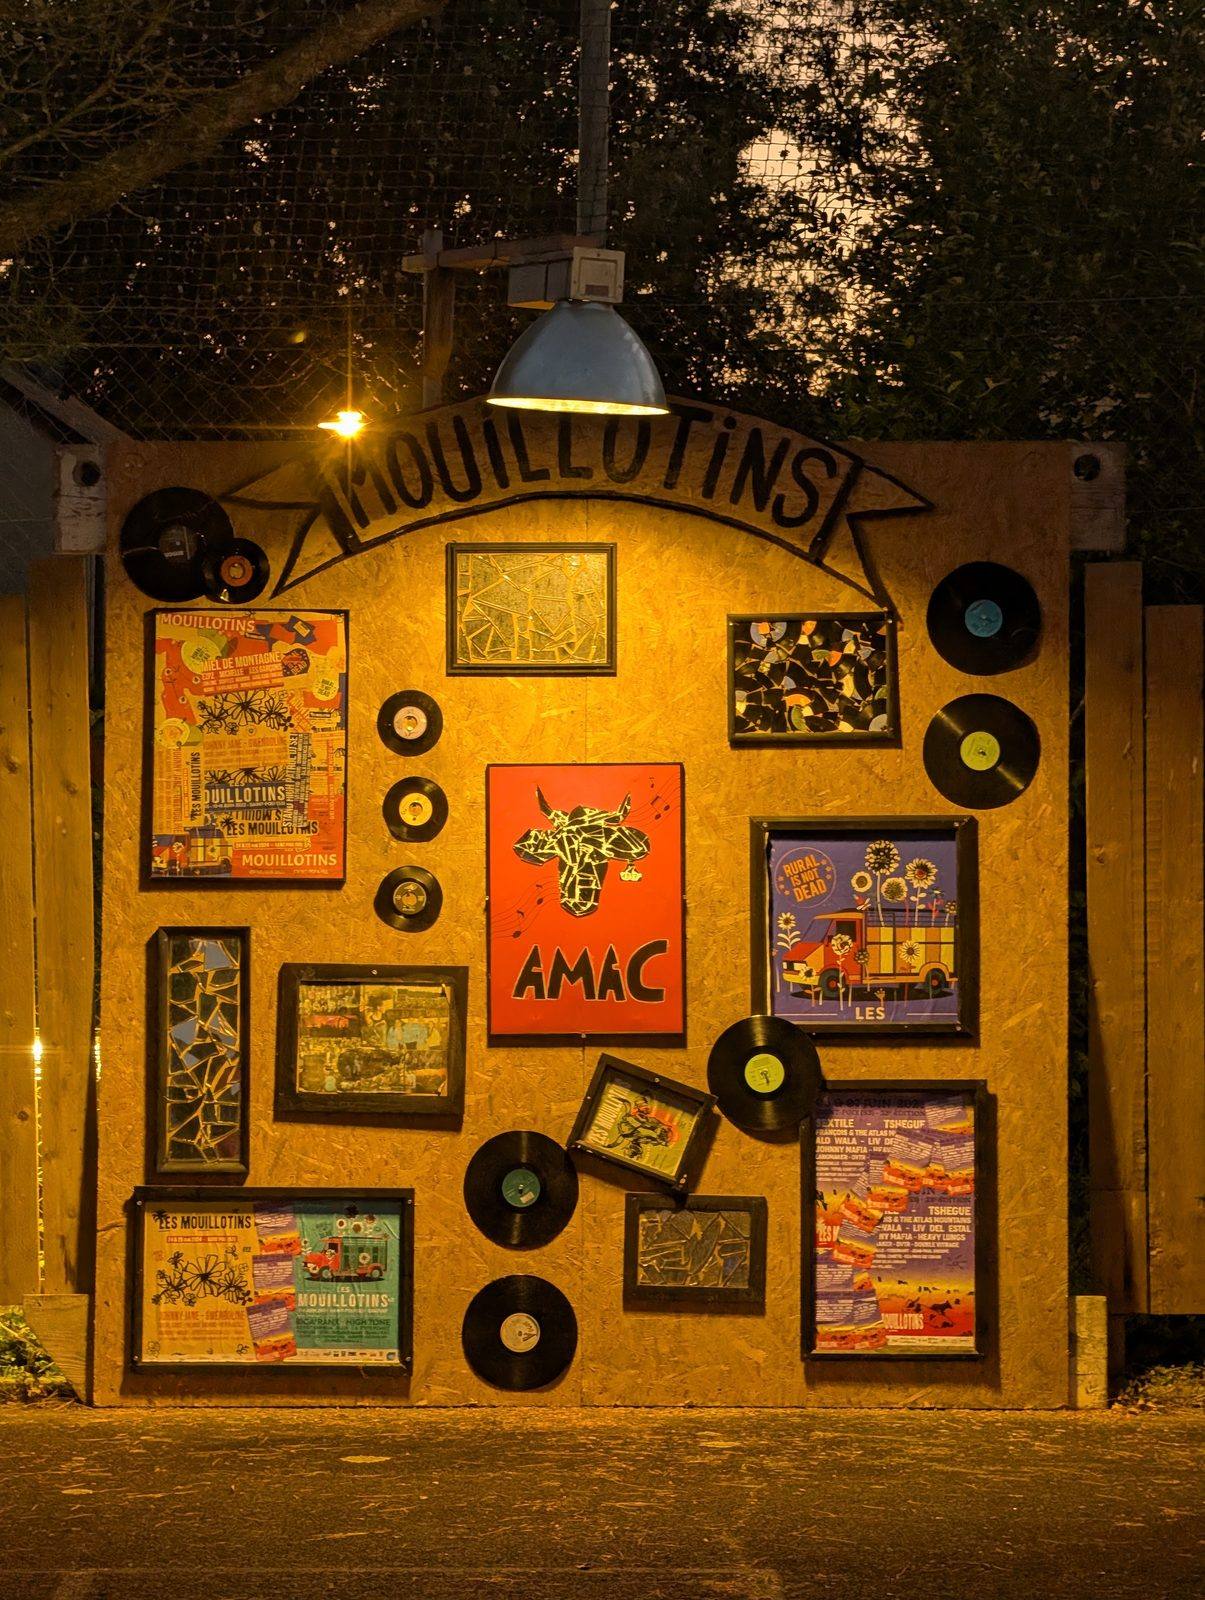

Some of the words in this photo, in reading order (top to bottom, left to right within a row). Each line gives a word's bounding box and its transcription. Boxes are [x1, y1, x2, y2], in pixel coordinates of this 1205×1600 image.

[160, 613, 255, 632] MOUILLOTINS
[201, 658, 221, 672] MIEL
[223, 657, 235, 668] DE
[236, 652, 283, 668] MONTAGNE
[191, 752, 201, 802] MOUILLOTINS
[242, 854, 337, 867] MOUILLOTINS
[783, 854, 821, 878] RURAL
[791, 875, 800, 887] IS
[800, 868, 820, 884] NOT
[793, 879, 828, 903] DEAD
[511, 938, 669, 1003] AMAC
[855, 1007, 885, 1020] LES
[928, 1206, 971, 1216] TSHEGUE
[159, 1215, 178, 1229] LES
[181, 1215, 251, 1229] MOUILLOTINS
[930, 1225, 945, 1233] DEL
[948, 1225, 971, 1233] ESTAL
[298, 1293, 389, 1308] MOUILLOTINS
